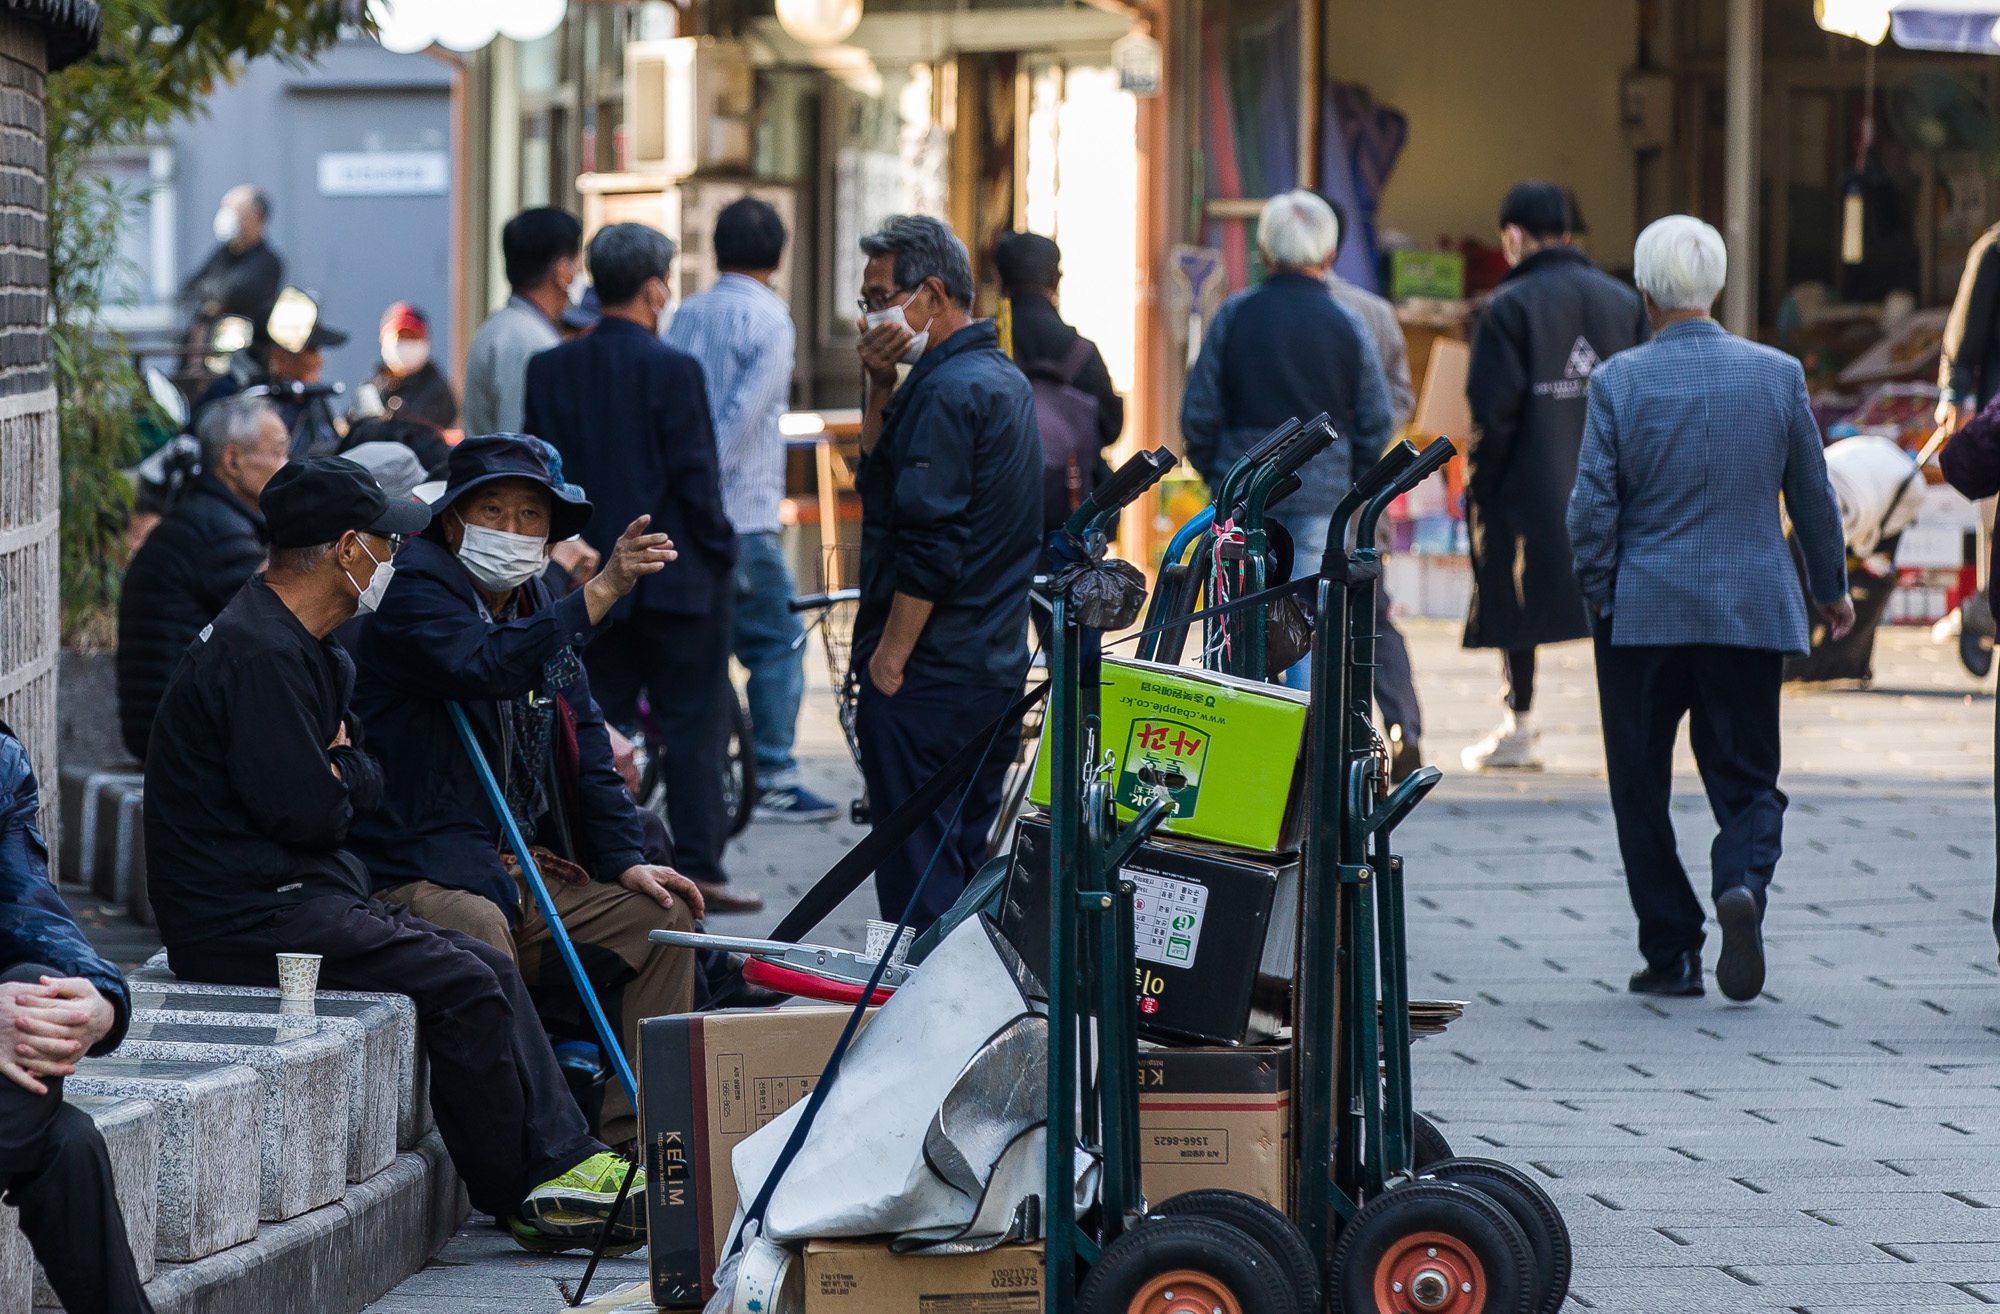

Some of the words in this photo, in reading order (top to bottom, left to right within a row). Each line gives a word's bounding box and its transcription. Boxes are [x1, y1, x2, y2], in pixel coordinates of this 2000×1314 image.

[1120, 696, 1226, 724] www.cbapple.co.kr
[1136, 724, 1201, 756] 사과
[722, 1080, 731, 1117] 1566-8625
[1154, 1136, 1208, 1146] 1566-8625
[658, 1132, 666, 1205] http://www.kelim.net
[666, 1132, 684, 1205] KELIM
[991, 1277, 1038, 1288] 025375
